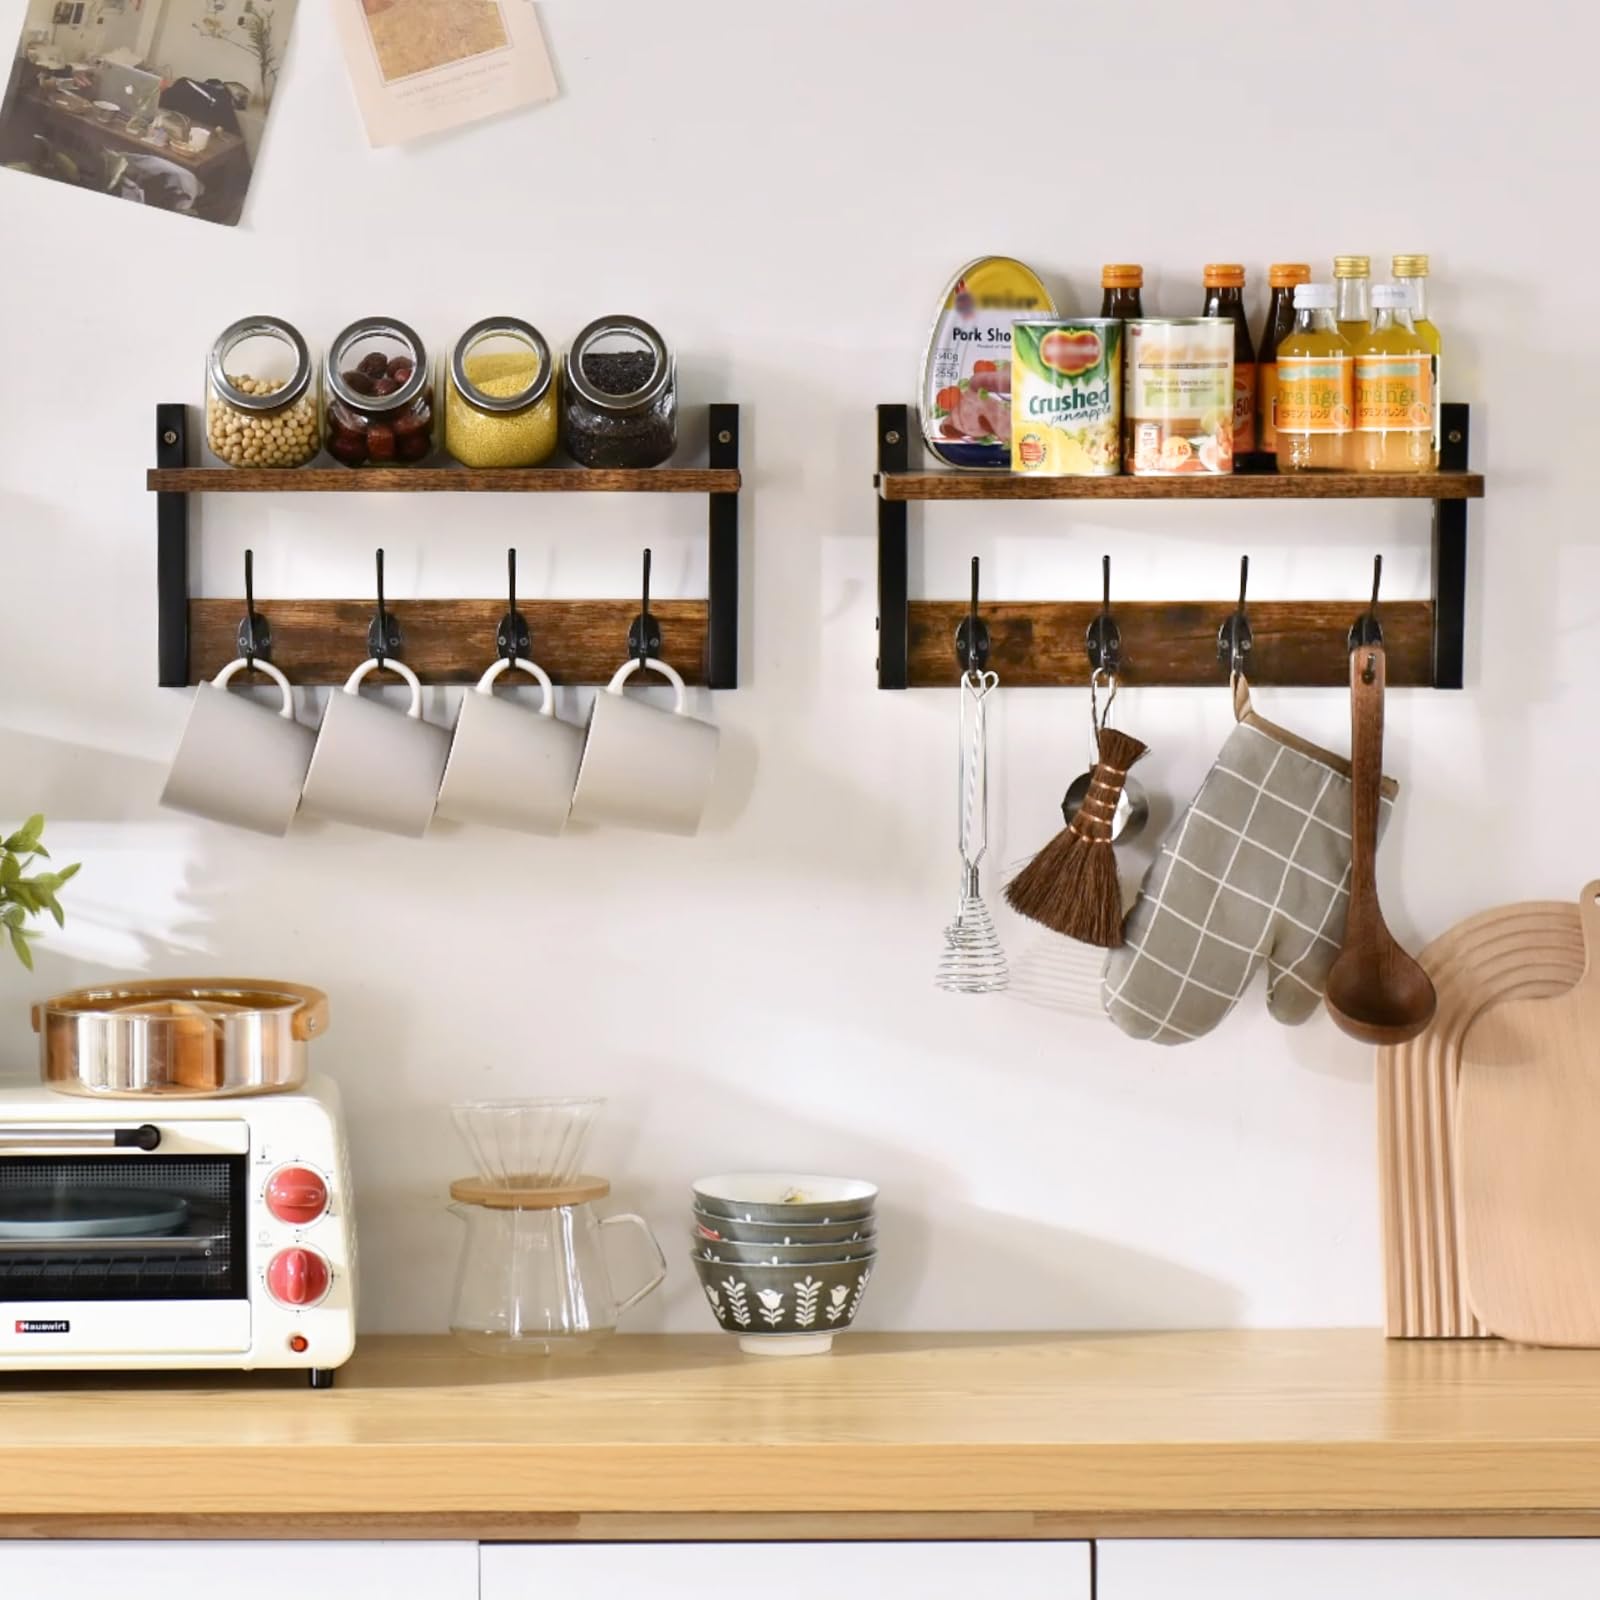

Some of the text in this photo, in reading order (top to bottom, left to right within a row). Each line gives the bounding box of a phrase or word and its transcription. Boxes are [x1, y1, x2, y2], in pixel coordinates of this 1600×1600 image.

[952, 327, 982, 341] Pork
[1029, 381, 1110, 415] Crushed
[1050, 404, 1111, 425] pineapple
